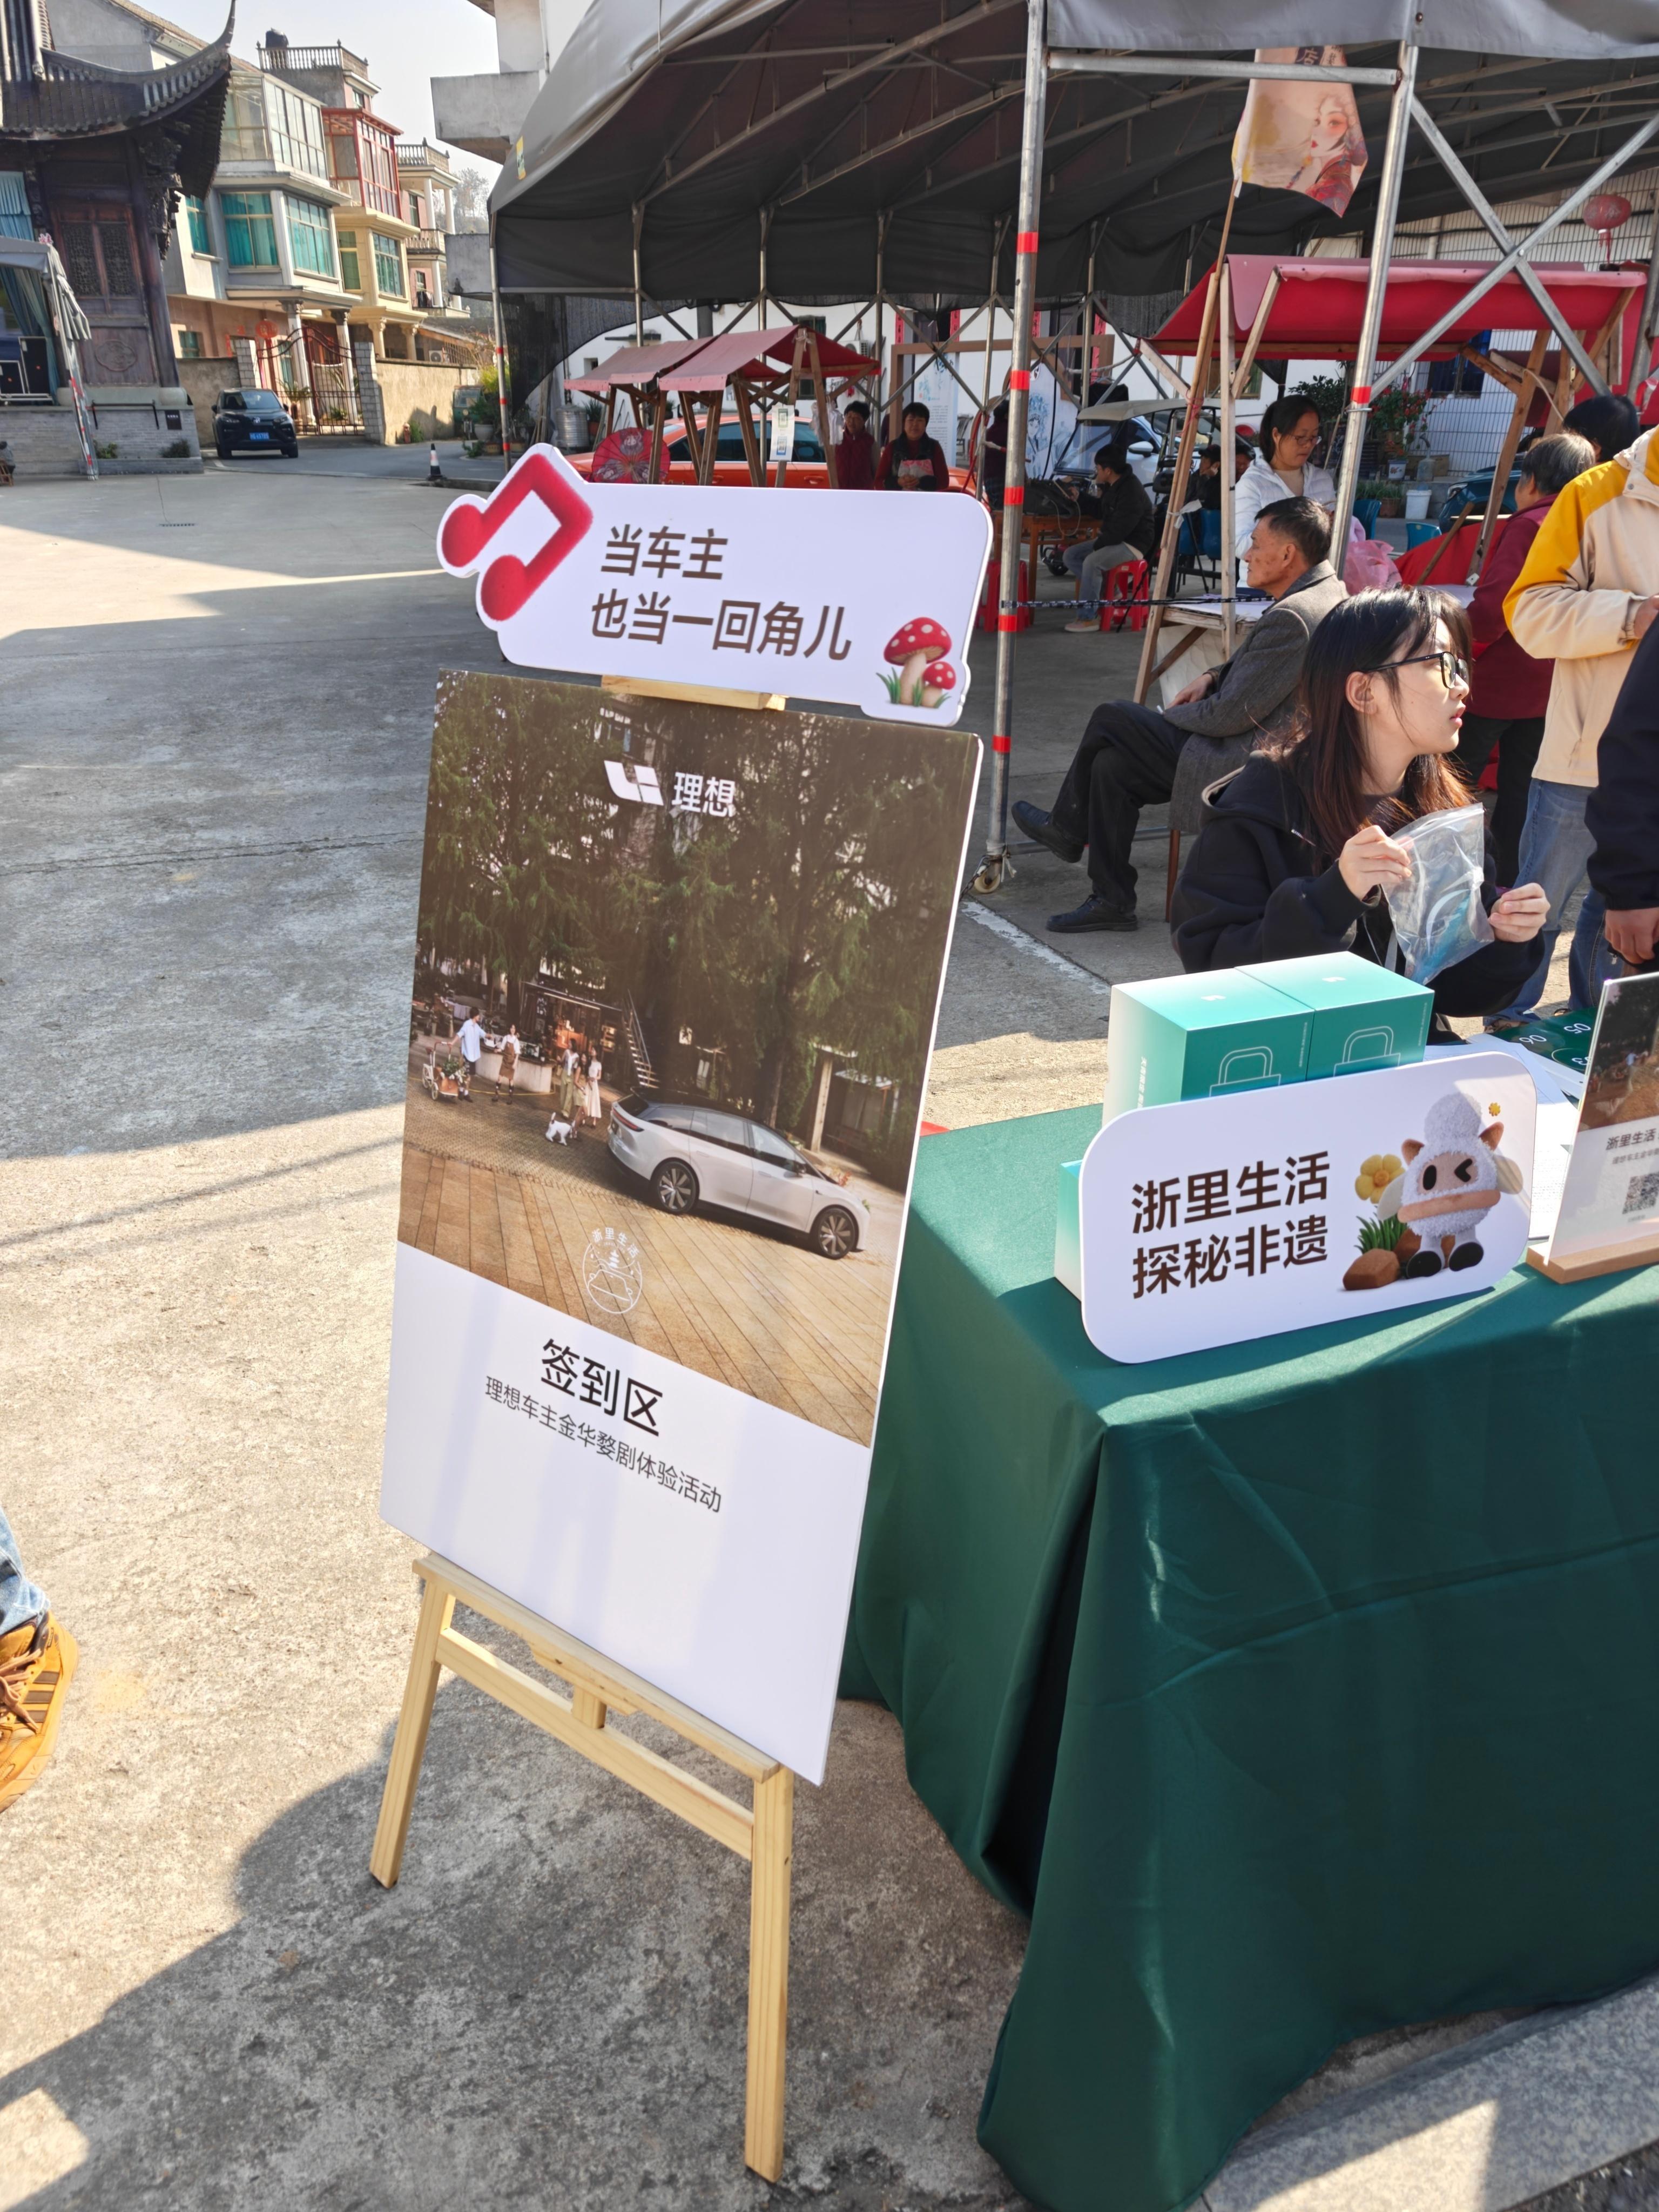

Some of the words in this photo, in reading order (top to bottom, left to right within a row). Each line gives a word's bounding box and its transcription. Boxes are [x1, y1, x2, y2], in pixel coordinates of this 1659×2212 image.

[601, 523, 729, 580] 当车主
[592, 588, 852, 661] 也当一回角儿
[671, 771, 737, 818] 理想
[1519, 1035, 1547, 1044] 06
[1563, 1023, 1591, 1034] 05
[1606, 1128, 1656, 1150] 浙里生活
[1132, 1150, 1330, 1234] 浙里生活
[591, 1226, 639, 1258] 浙里生活
[1132, 1214, 1328, 1299] 探秘非遗
[541, 1338, 664, 1437] 签到区
[484, 1375, 723, 1513] 理想车主金华婺剧体验活动
